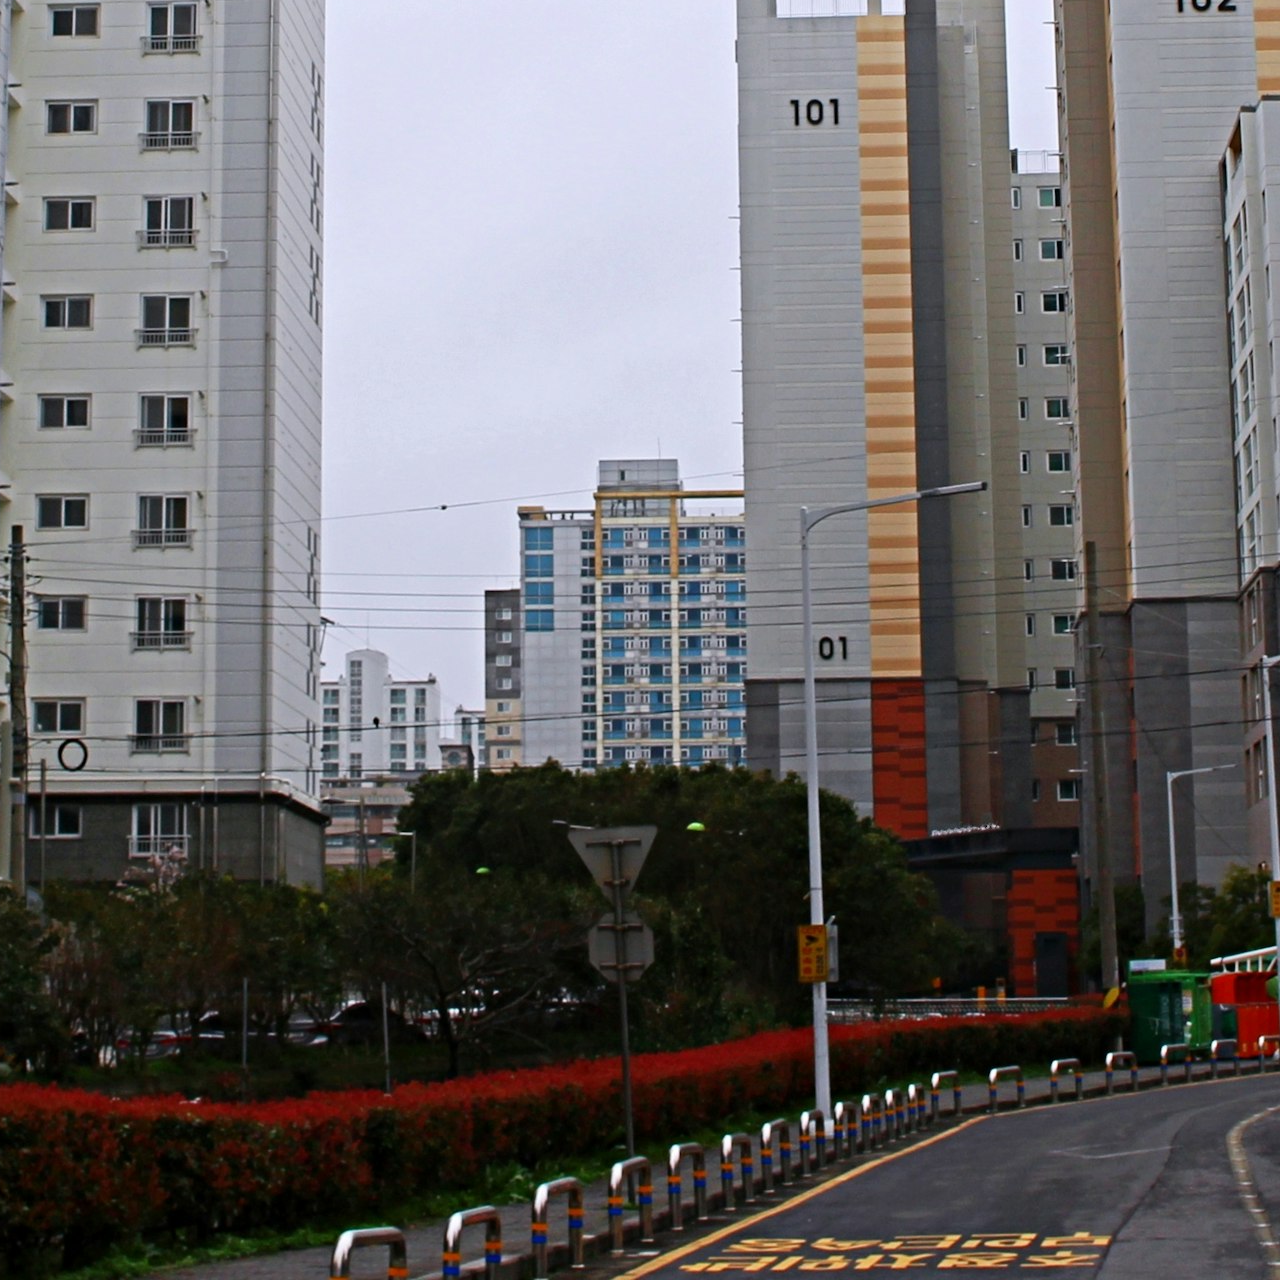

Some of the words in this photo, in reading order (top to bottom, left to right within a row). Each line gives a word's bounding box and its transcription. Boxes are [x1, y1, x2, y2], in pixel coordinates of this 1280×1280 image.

[789, 98, 841, 127] 101
[818, 636, 848, 660] 01
[722, 1231, 1113, 1254] 무인단속중
[680, 1251, 1102, 1273] 주정차위반
